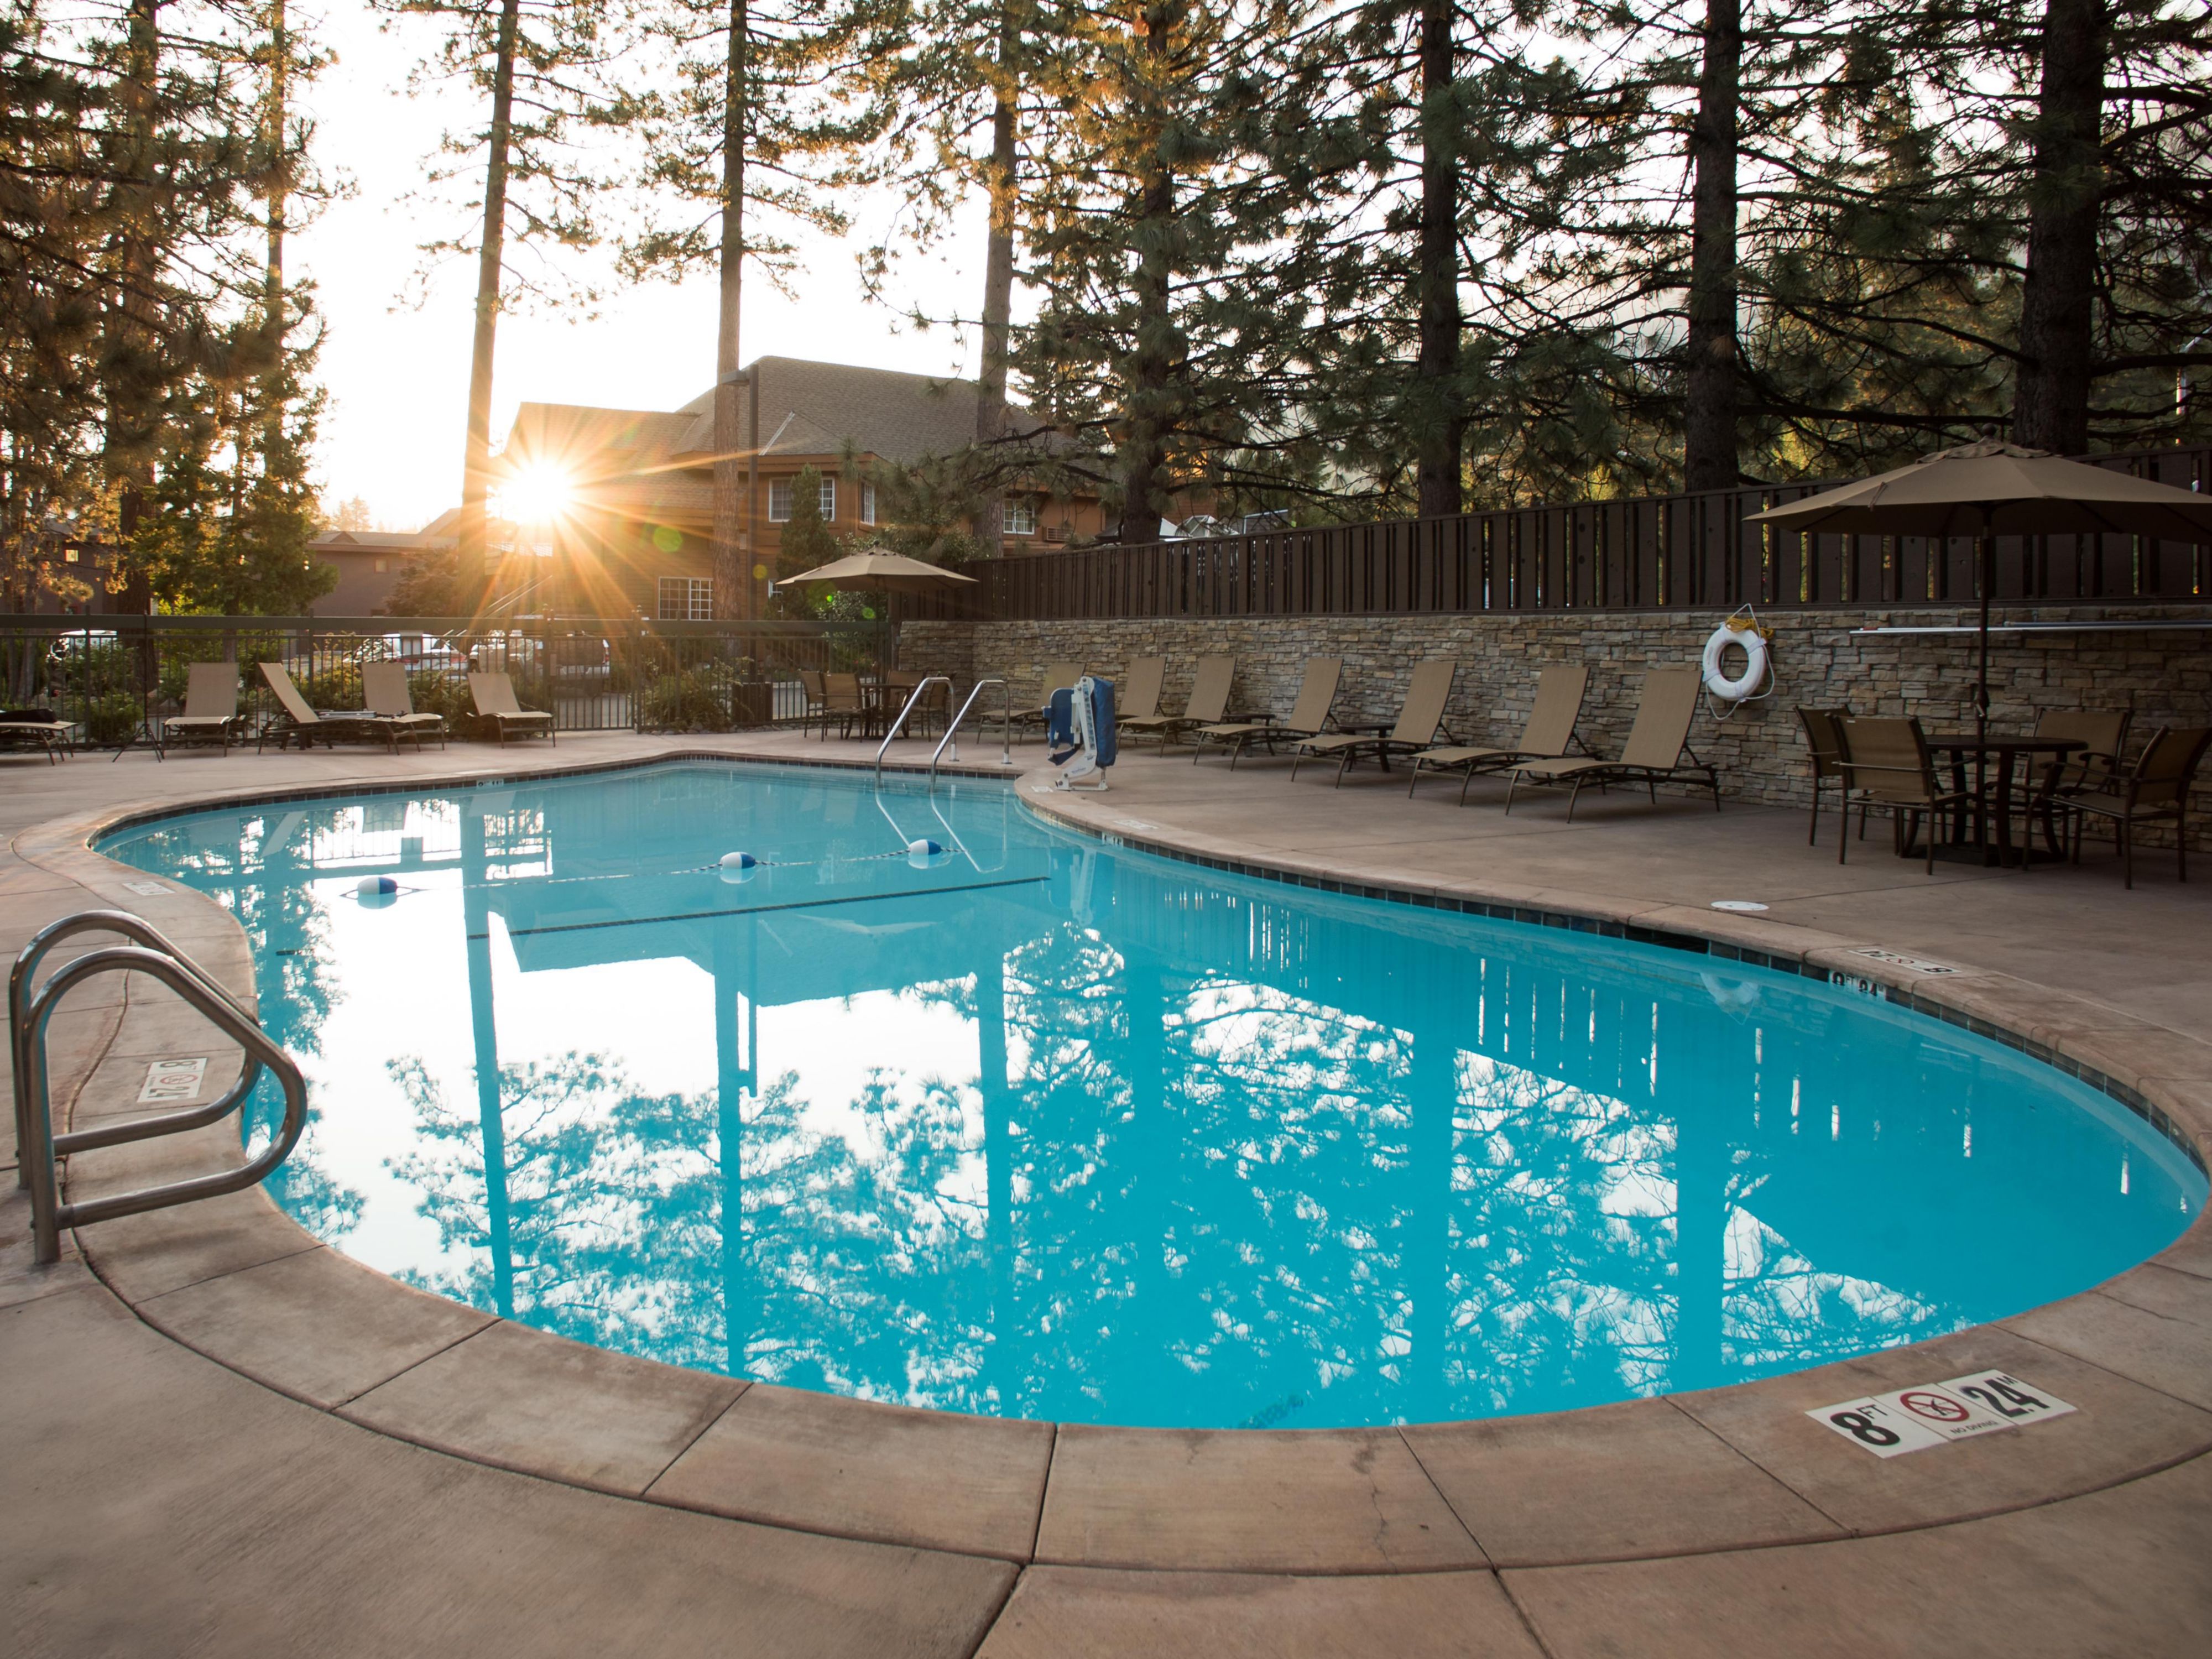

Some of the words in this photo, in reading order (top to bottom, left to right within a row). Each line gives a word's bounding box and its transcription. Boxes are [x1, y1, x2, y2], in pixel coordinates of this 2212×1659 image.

[1995, 1375, 2018, 1385] M
[1855, 1404, 1888, 1420] FT
[1829, 1411, 1901, 1446] 8
[1965, 1420, 1999, 1431] DIVING
